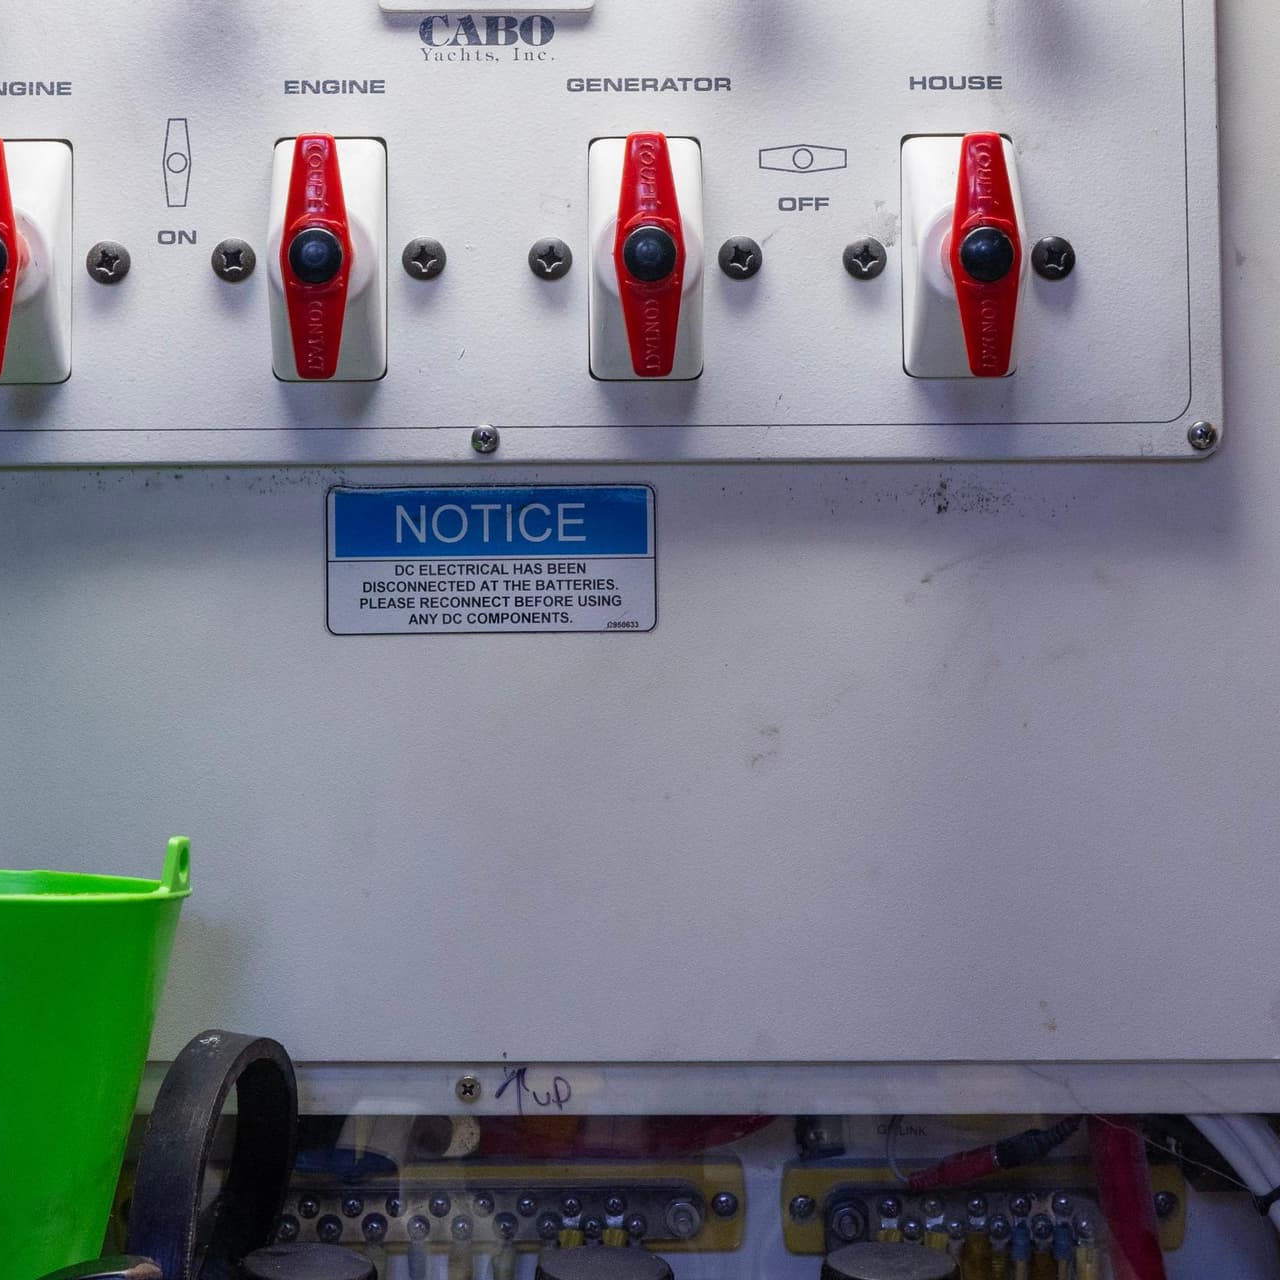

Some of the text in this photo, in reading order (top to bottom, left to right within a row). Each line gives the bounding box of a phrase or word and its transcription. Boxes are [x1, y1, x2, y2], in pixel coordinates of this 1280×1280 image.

[418, 14, 556, 47] CABO
[420, 47, 556, 63] Yachts, Inc.
[283, 79, 386, 95] ENGINE
[566, 76, 732, 93] GENERATOR
[909, 75, 1003, 91] HOUSE
[778, 196, 830, 212] OFF
[157, 230, 197, 245] ON
[395, 502, 587, 544] NOTICE
[394, 563, 586, 576] DC ELECTRICAL HAS BEEN
[362, 578, 619, 593] DISCONNECTED AT THE BATTERIES.
[360, 595, 622, 609] PLEASE RECONNECT BEFORE USING
[409, 612, 573, 625] ANY DC COMPONENTS.
